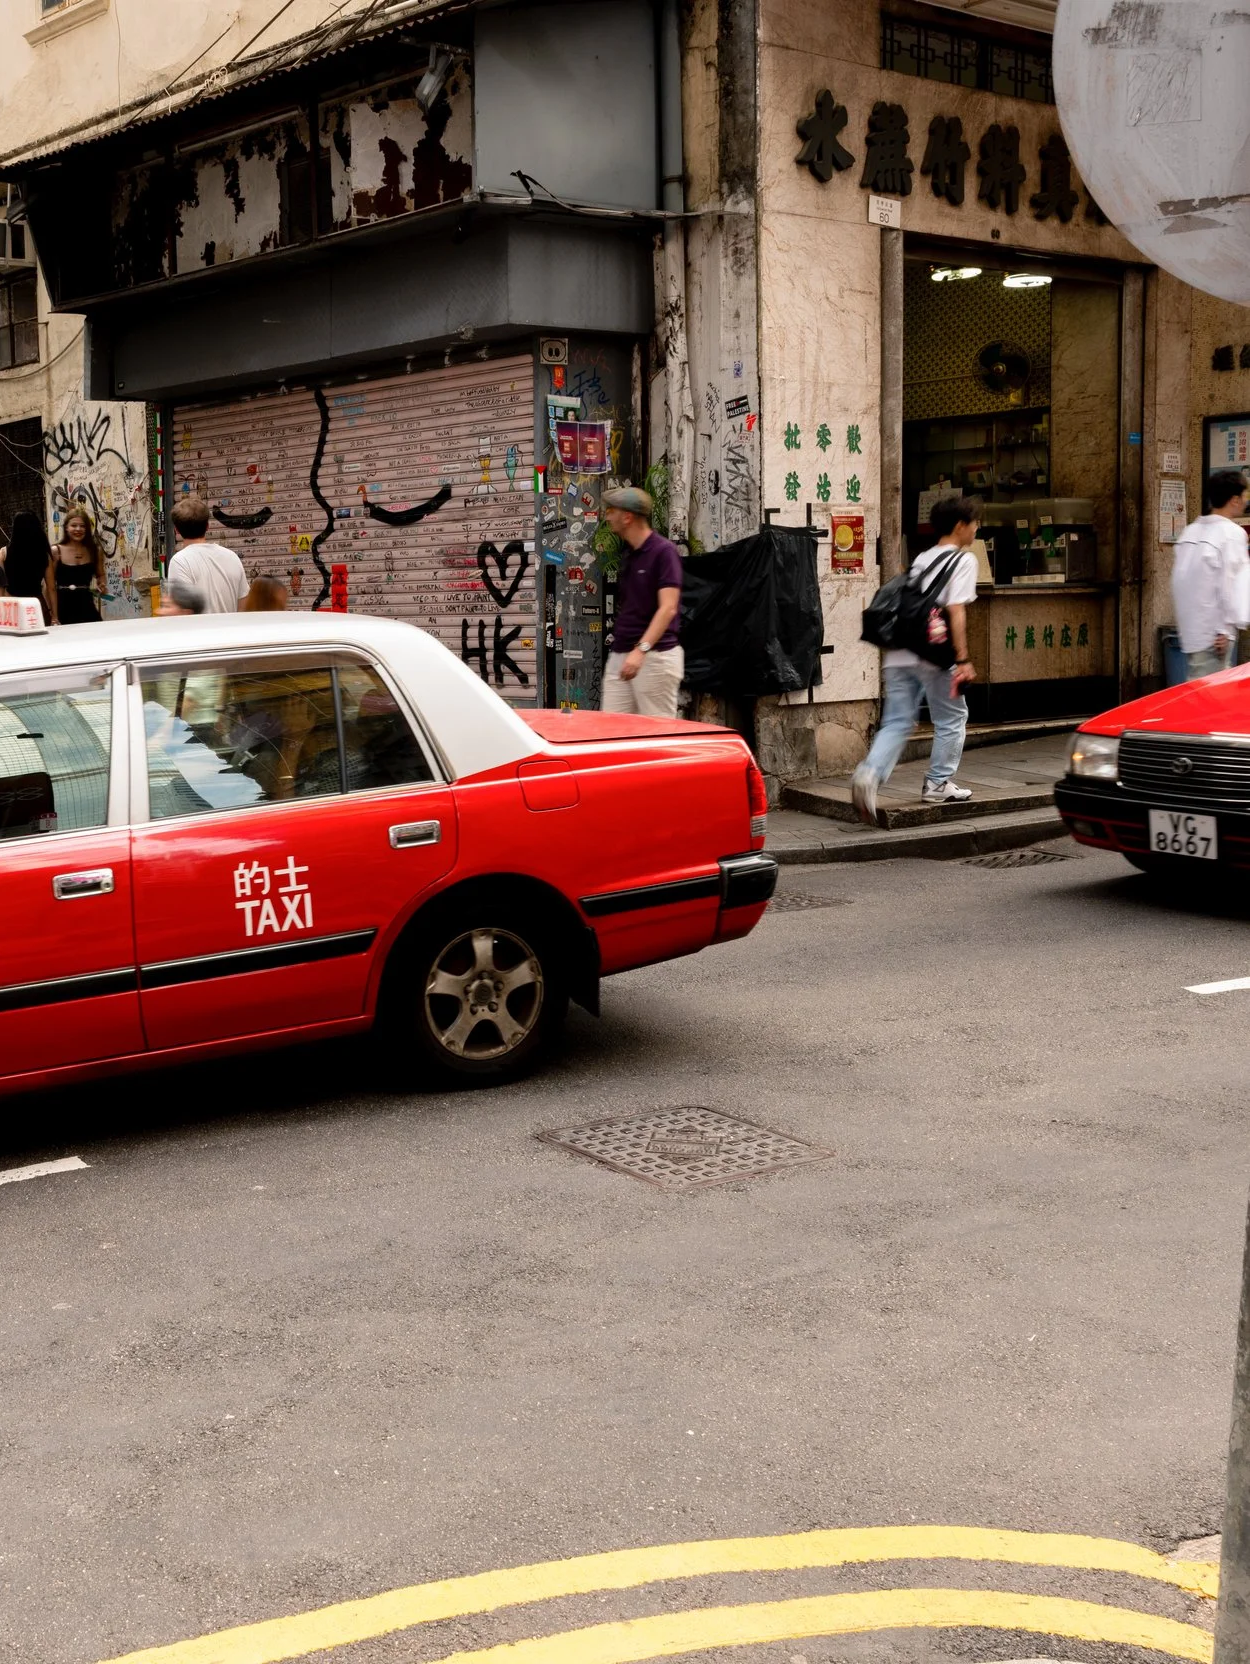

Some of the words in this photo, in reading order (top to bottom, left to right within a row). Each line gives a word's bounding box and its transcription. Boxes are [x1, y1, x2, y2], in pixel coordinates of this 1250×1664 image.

[880, 212, 889, 223] 60
[990, 229, 1000, 240] 60
[727, 406, 749, 417] PALESTINE
[784, 421, 801, 502] 批發
[846, 424, 862, 503] 歡迎
[26, 606, 38, 628] 的士
[462, 616, 528, 684] HK
[1168, 814, 1198, 835] VG
[1156, 832, 1212, 856] 8667
[234, 856, 309, 897] 的士
[235, 893, 314, 936] TAXI
